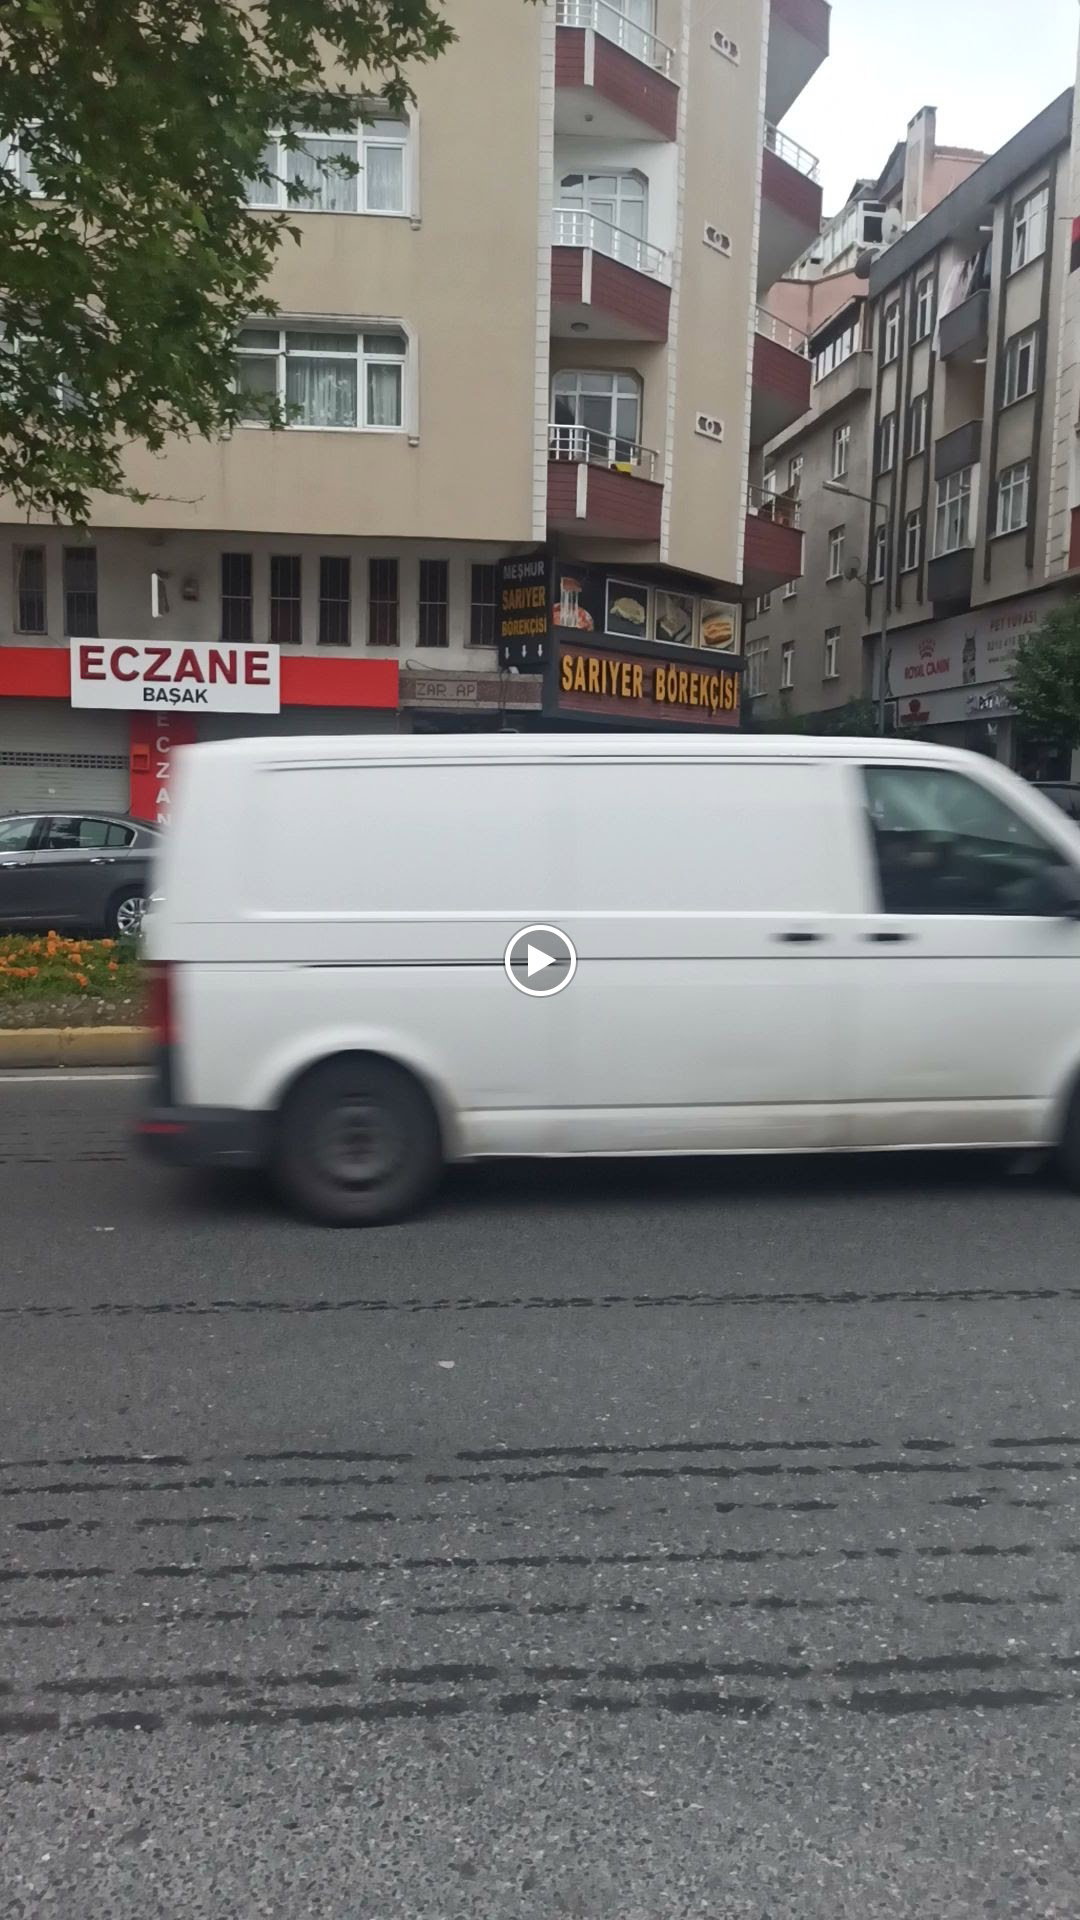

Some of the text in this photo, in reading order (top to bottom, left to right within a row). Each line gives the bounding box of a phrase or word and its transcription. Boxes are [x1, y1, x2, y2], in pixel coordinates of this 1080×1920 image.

[503, 561, 545, 581] MEŞHUR
[502, 586, 545, 610] SARIYER
[79, 645, 271, 685] ECZANE
[143, 687, 208, 706] BAŞAK
[562, 654, 738, 715] SARIYER BÖREKÇİSİ
